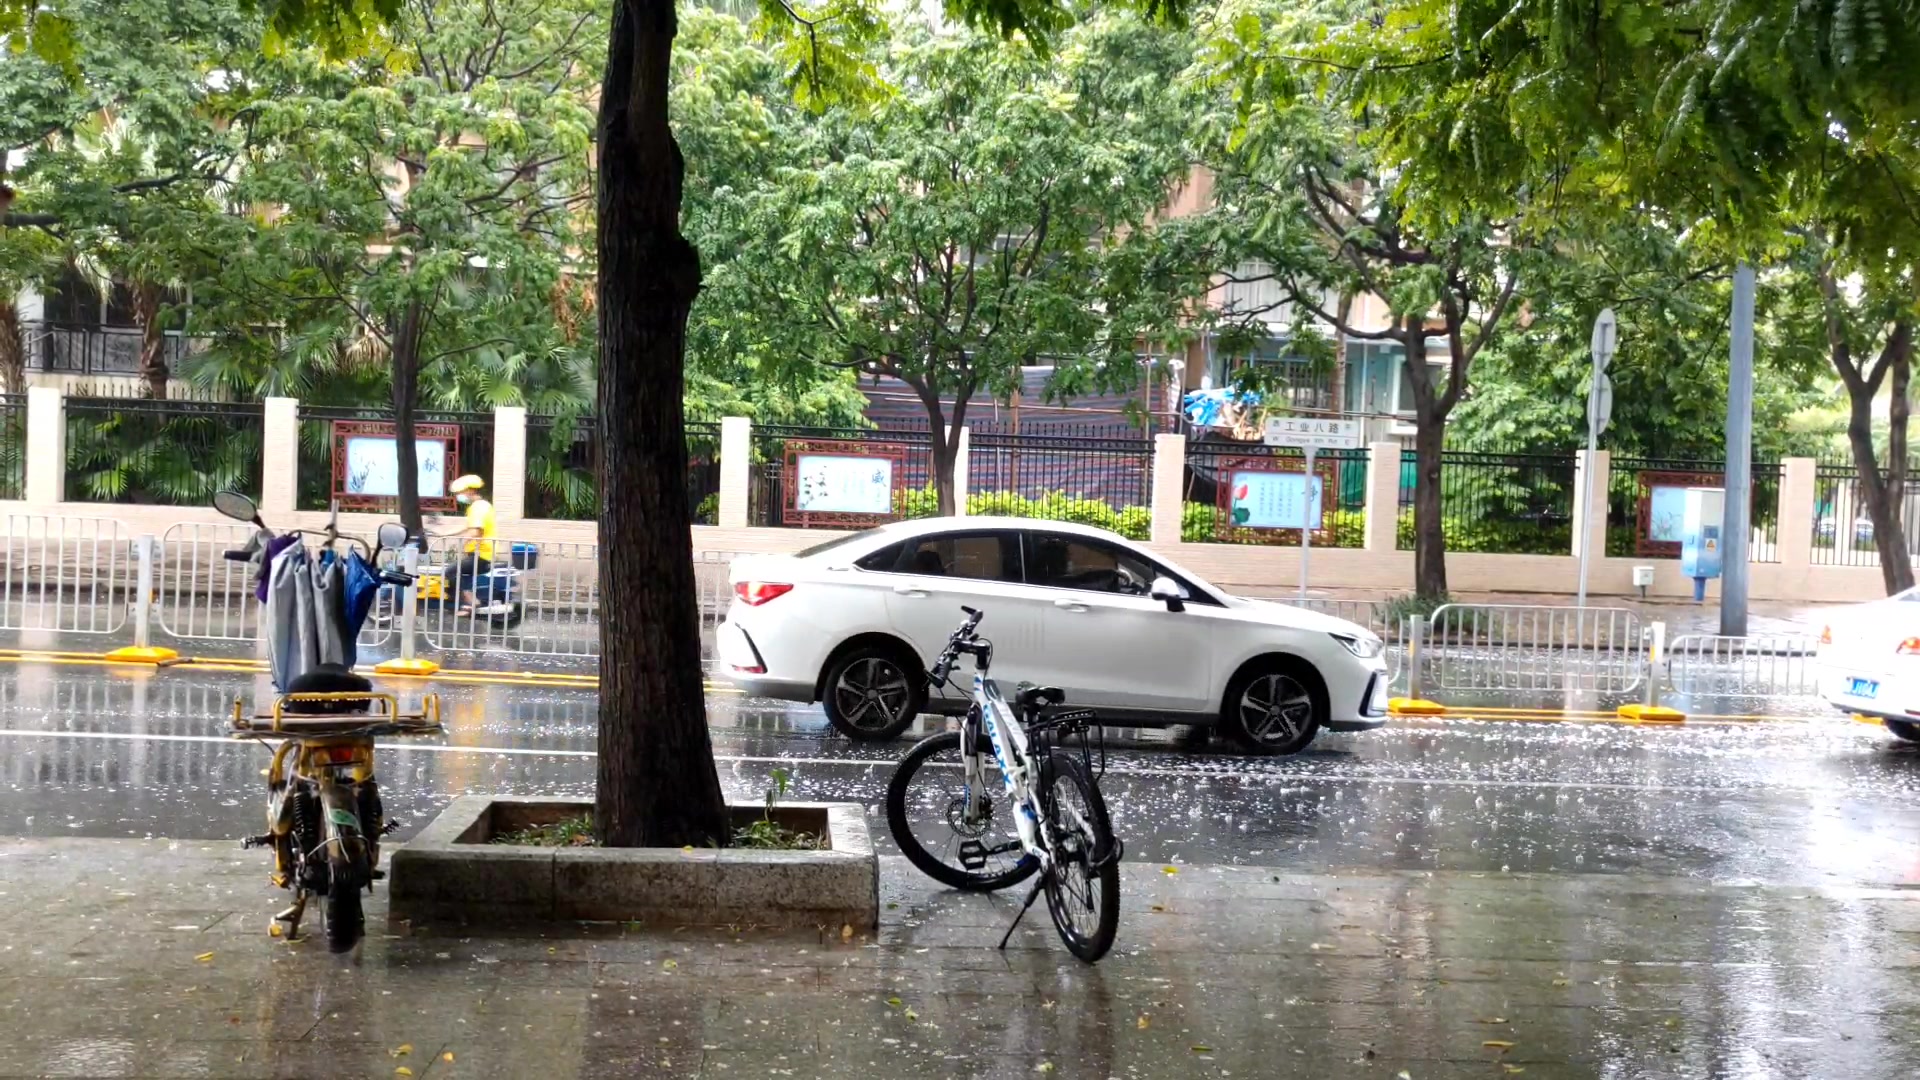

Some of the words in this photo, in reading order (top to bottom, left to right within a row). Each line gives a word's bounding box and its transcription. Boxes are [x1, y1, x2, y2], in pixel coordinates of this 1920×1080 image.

[1285, 421, 1340, 434] 工业八路
[1285, 436, 1310, 444] Gongye
